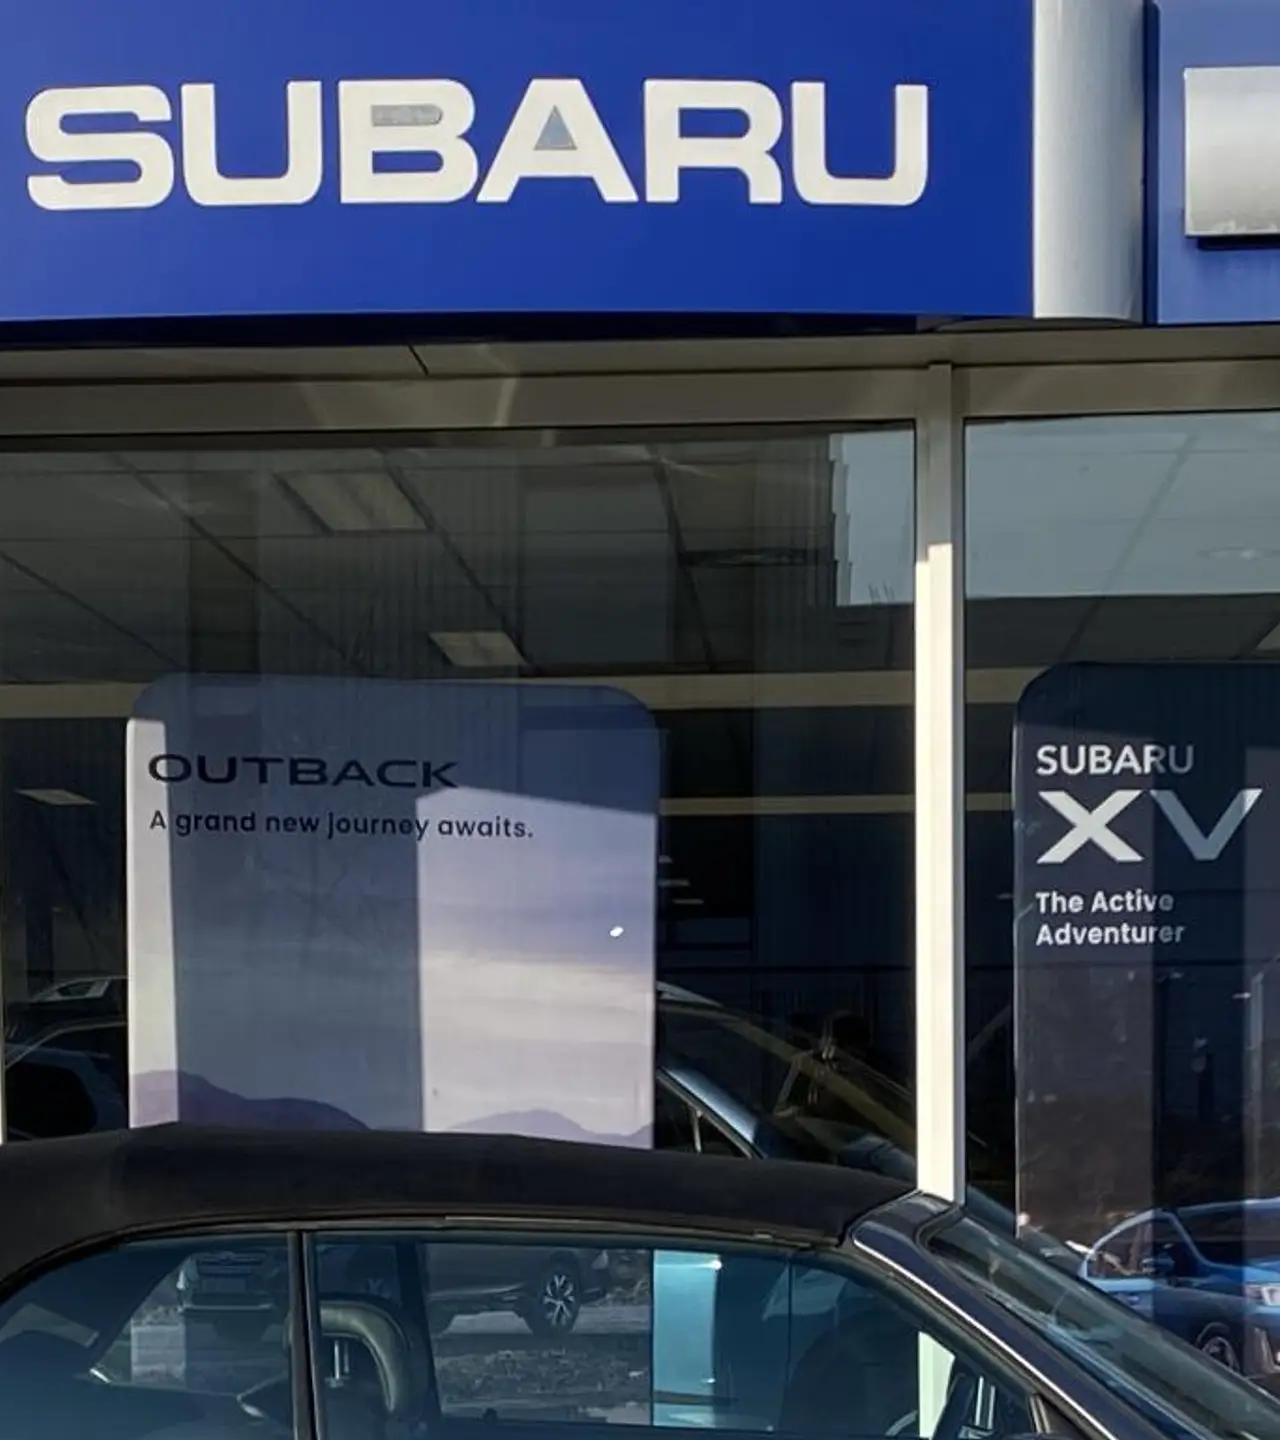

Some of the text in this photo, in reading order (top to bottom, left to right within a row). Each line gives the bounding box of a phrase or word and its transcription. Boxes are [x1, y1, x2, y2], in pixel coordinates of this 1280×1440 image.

[24, 77, 930, 211] SUBARU
[148, 753, 460, 788] OUTBACK
[1035, 744, 1195, 776] SUBARU
[150, 810, 535, 841] A grand new journey awaits.
[1035, 788, 1263, 864] XV
[1035, 888, 1174, 914] The Active
[1035, 922, 1186, 947] Adventurer
